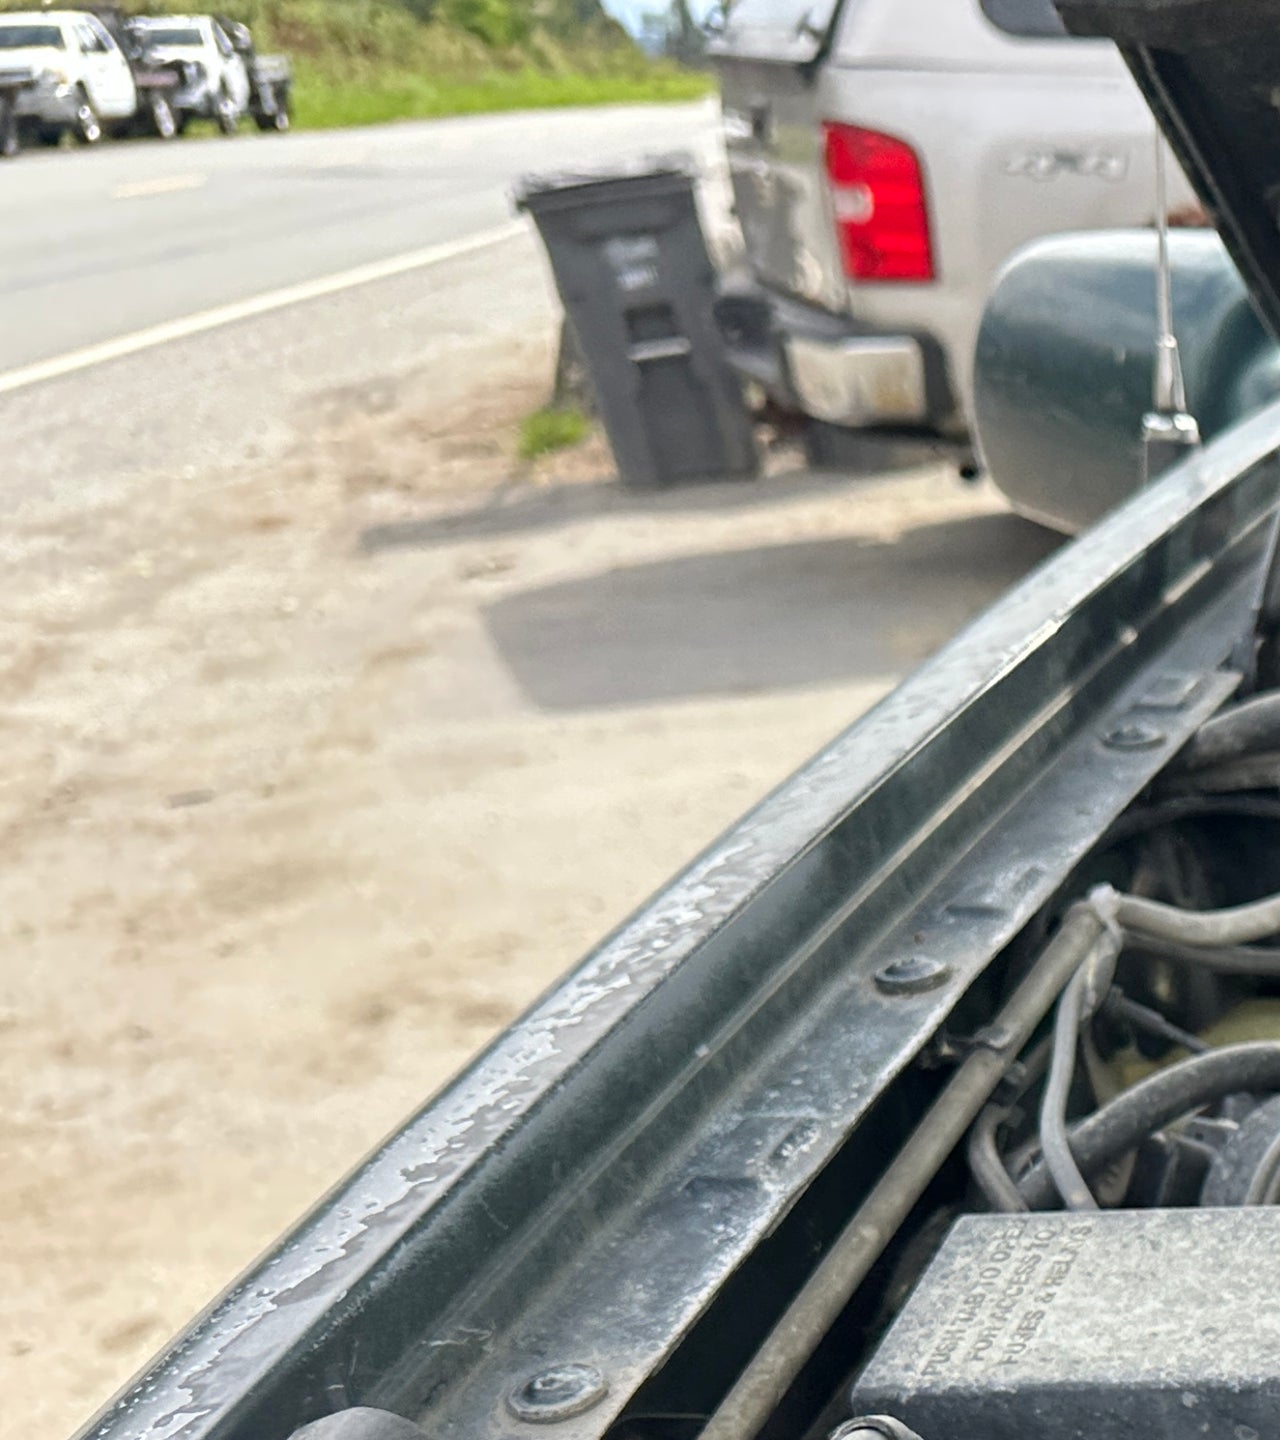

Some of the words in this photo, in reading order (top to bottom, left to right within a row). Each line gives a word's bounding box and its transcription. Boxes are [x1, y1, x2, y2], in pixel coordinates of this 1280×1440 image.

[920, 1327, 966, 1376] PUSH
[950, 1291, 986, 1327] TAB
[973, 1267, 1002, 1291] TO
[968, 1326, 1002, 1362] FOR
[990, 1253, 1042, 1322] ACCESS
[1025, 1229, 1057, 1251] TO
[998, 1310, 1046, 1365] FUSES
[1034, 1290, 1057, 1304] &
